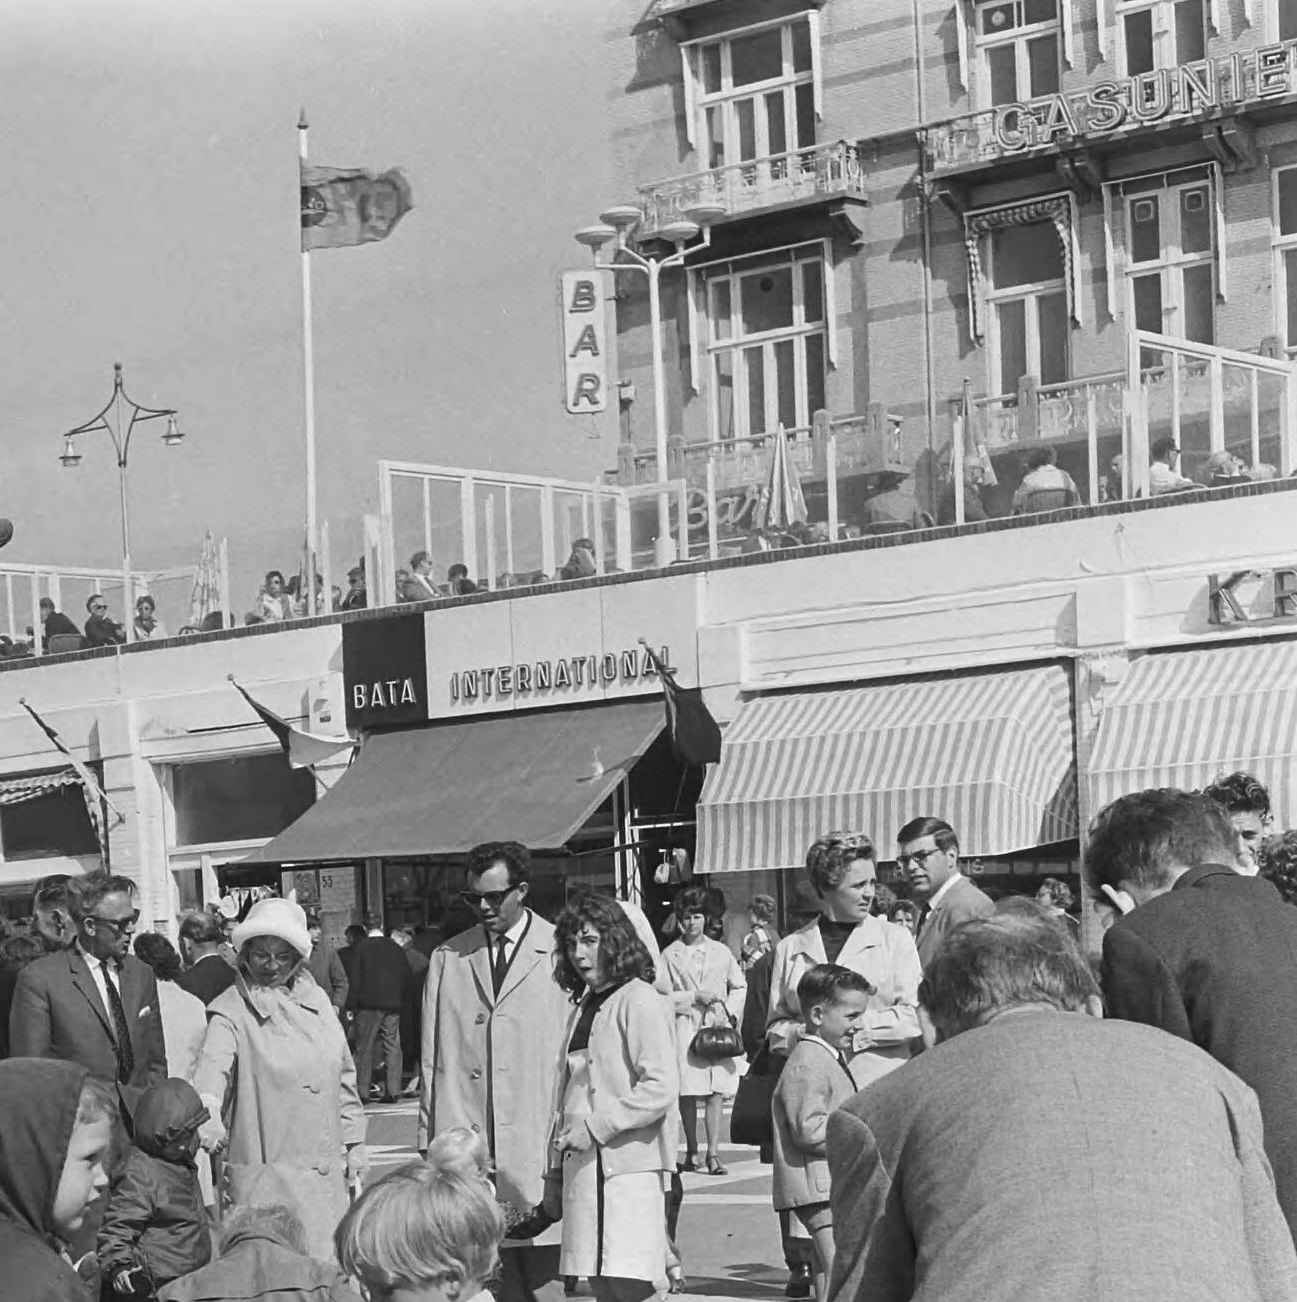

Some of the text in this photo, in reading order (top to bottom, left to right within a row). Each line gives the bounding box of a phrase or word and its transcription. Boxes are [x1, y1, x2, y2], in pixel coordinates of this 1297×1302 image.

[993, 43, 1291, 150] GASUNIE
[569, 280, 600, 406] BAR
[353, 677, 417, 709] BATA
[450, 646, 678, 701] INTERNATIONAL
